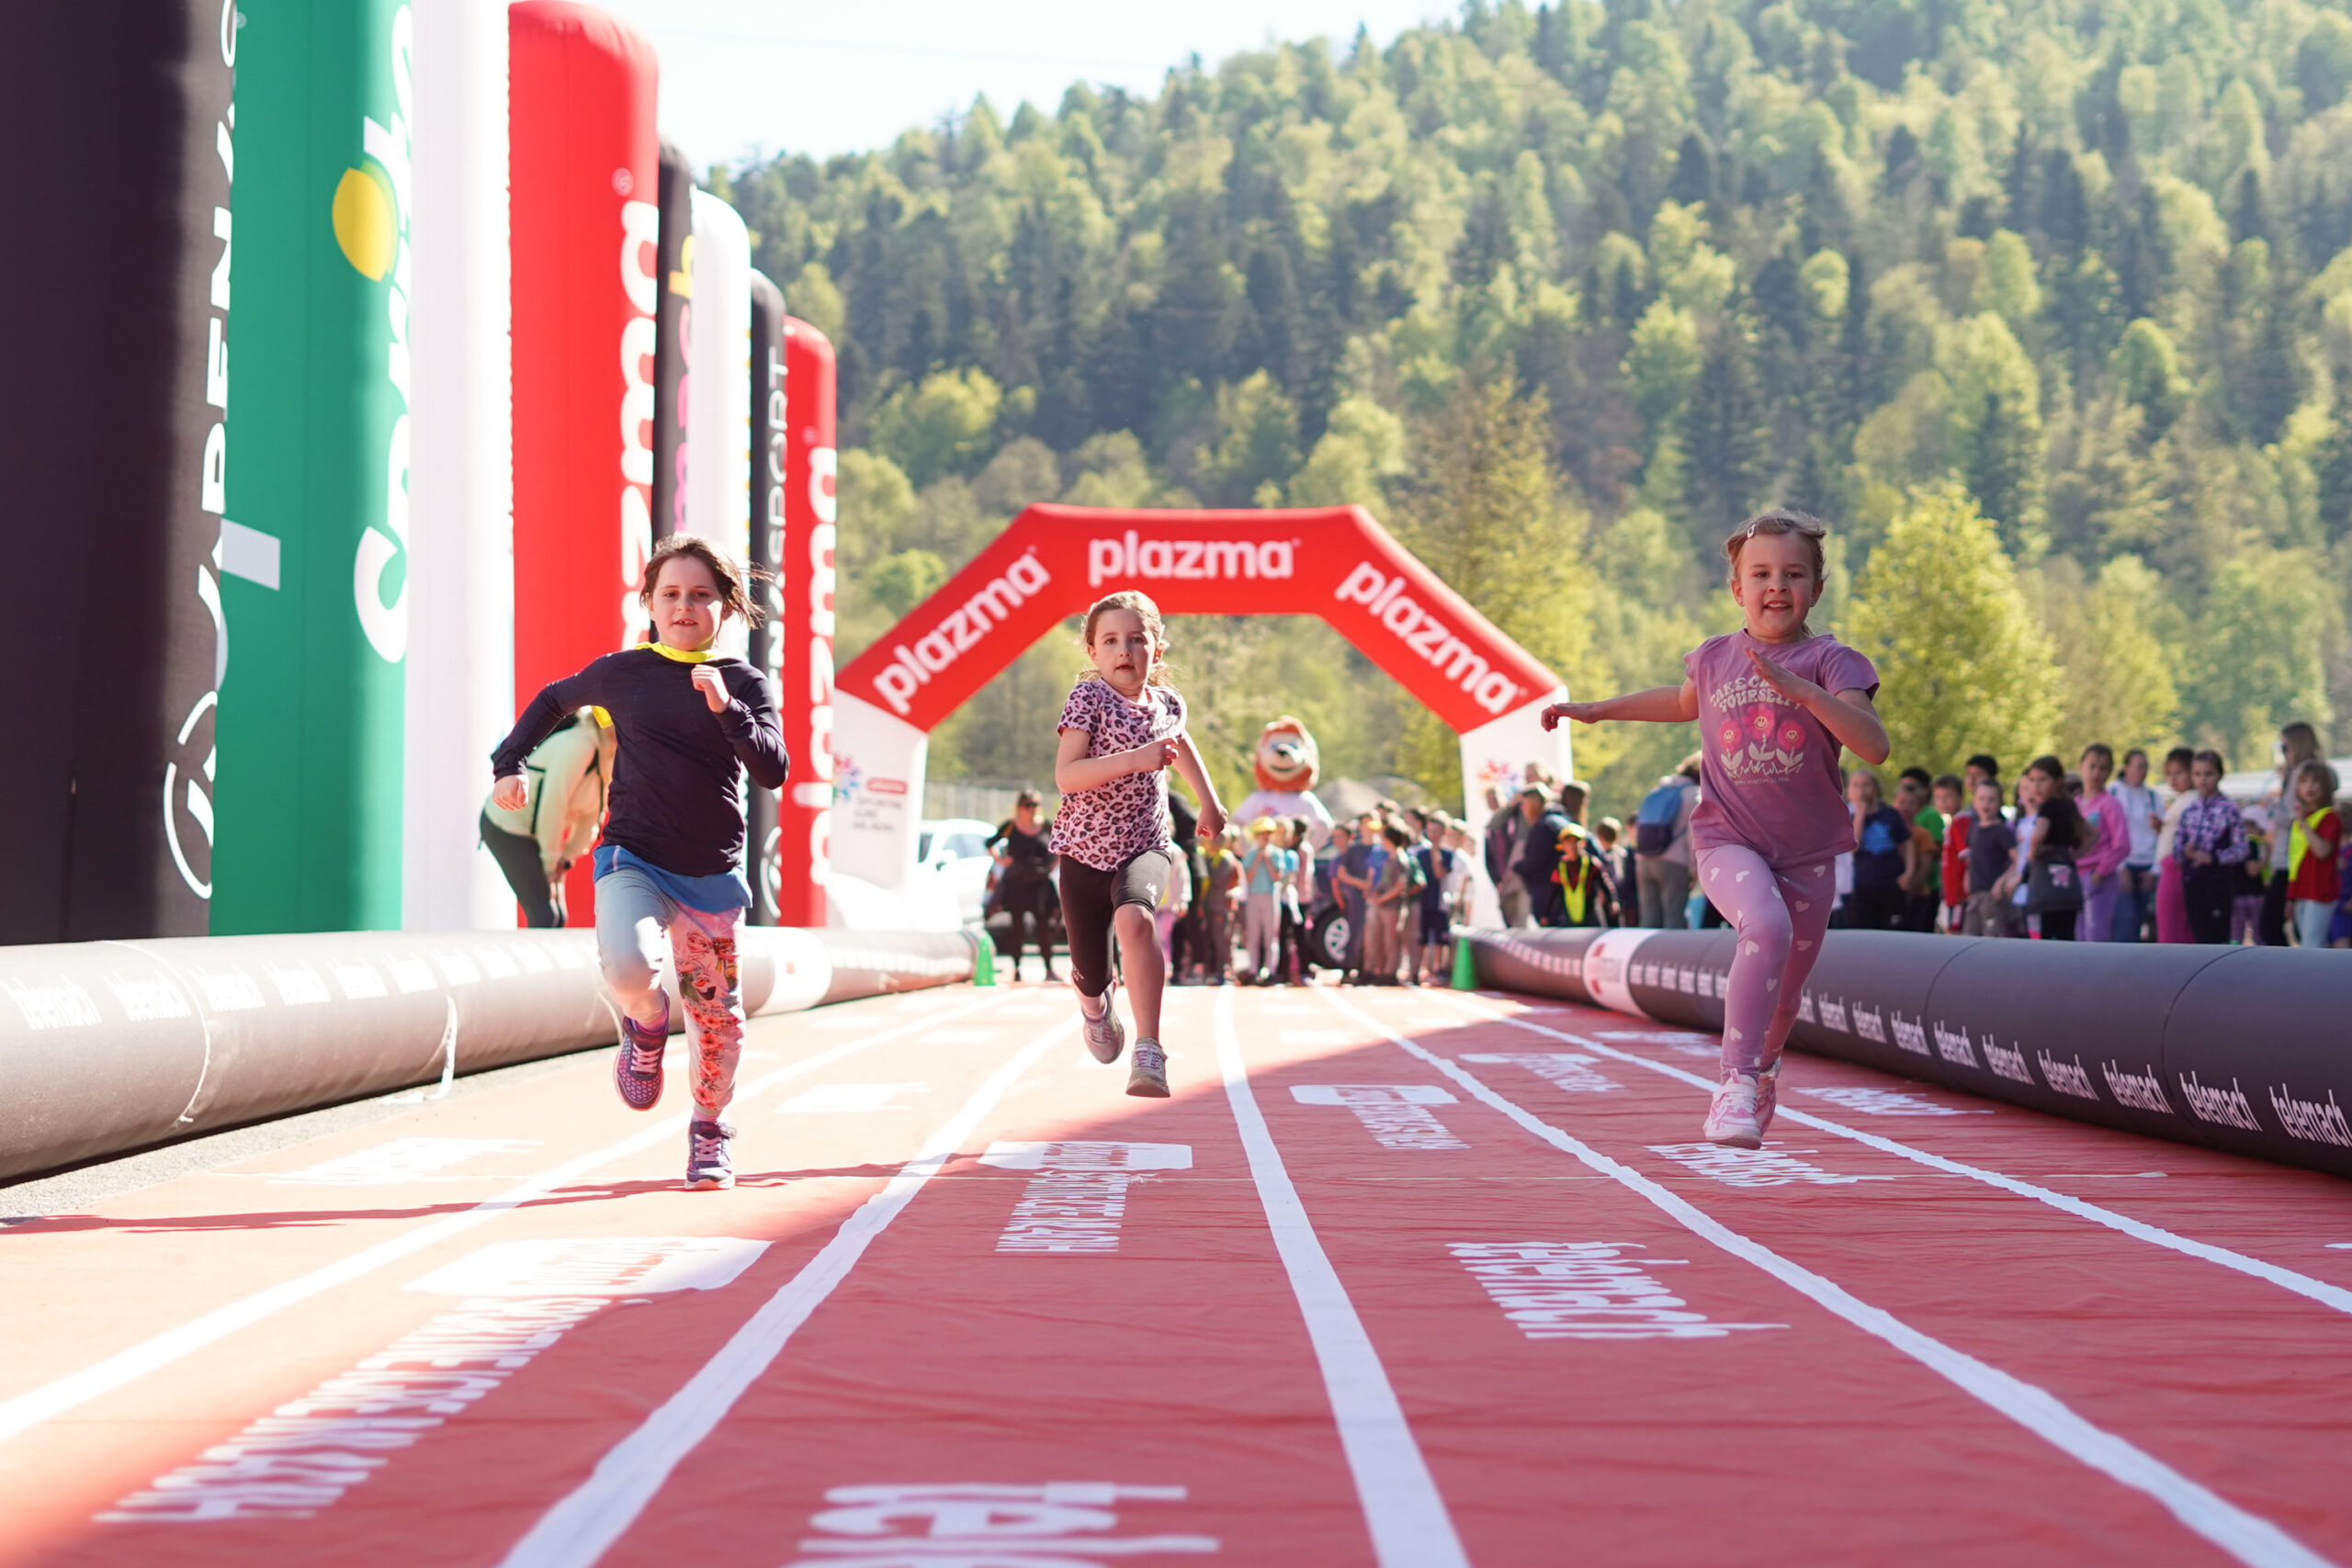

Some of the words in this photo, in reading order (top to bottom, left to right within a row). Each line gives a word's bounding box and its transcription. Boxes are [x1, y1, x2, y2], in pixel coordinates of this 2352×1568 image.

[1088, 529, 1294, 588] plazma
[874, 553, 1051, 716] plazma
[1334, 561, 1518, 715] plazma
[1710, 677, 1747, 707] TAKE
[2102, 1058, 2176, 1115] telemach
[2179, 1070, 2263, 1132] telemach
[1444, 1240, 1792, 1338] telemach
